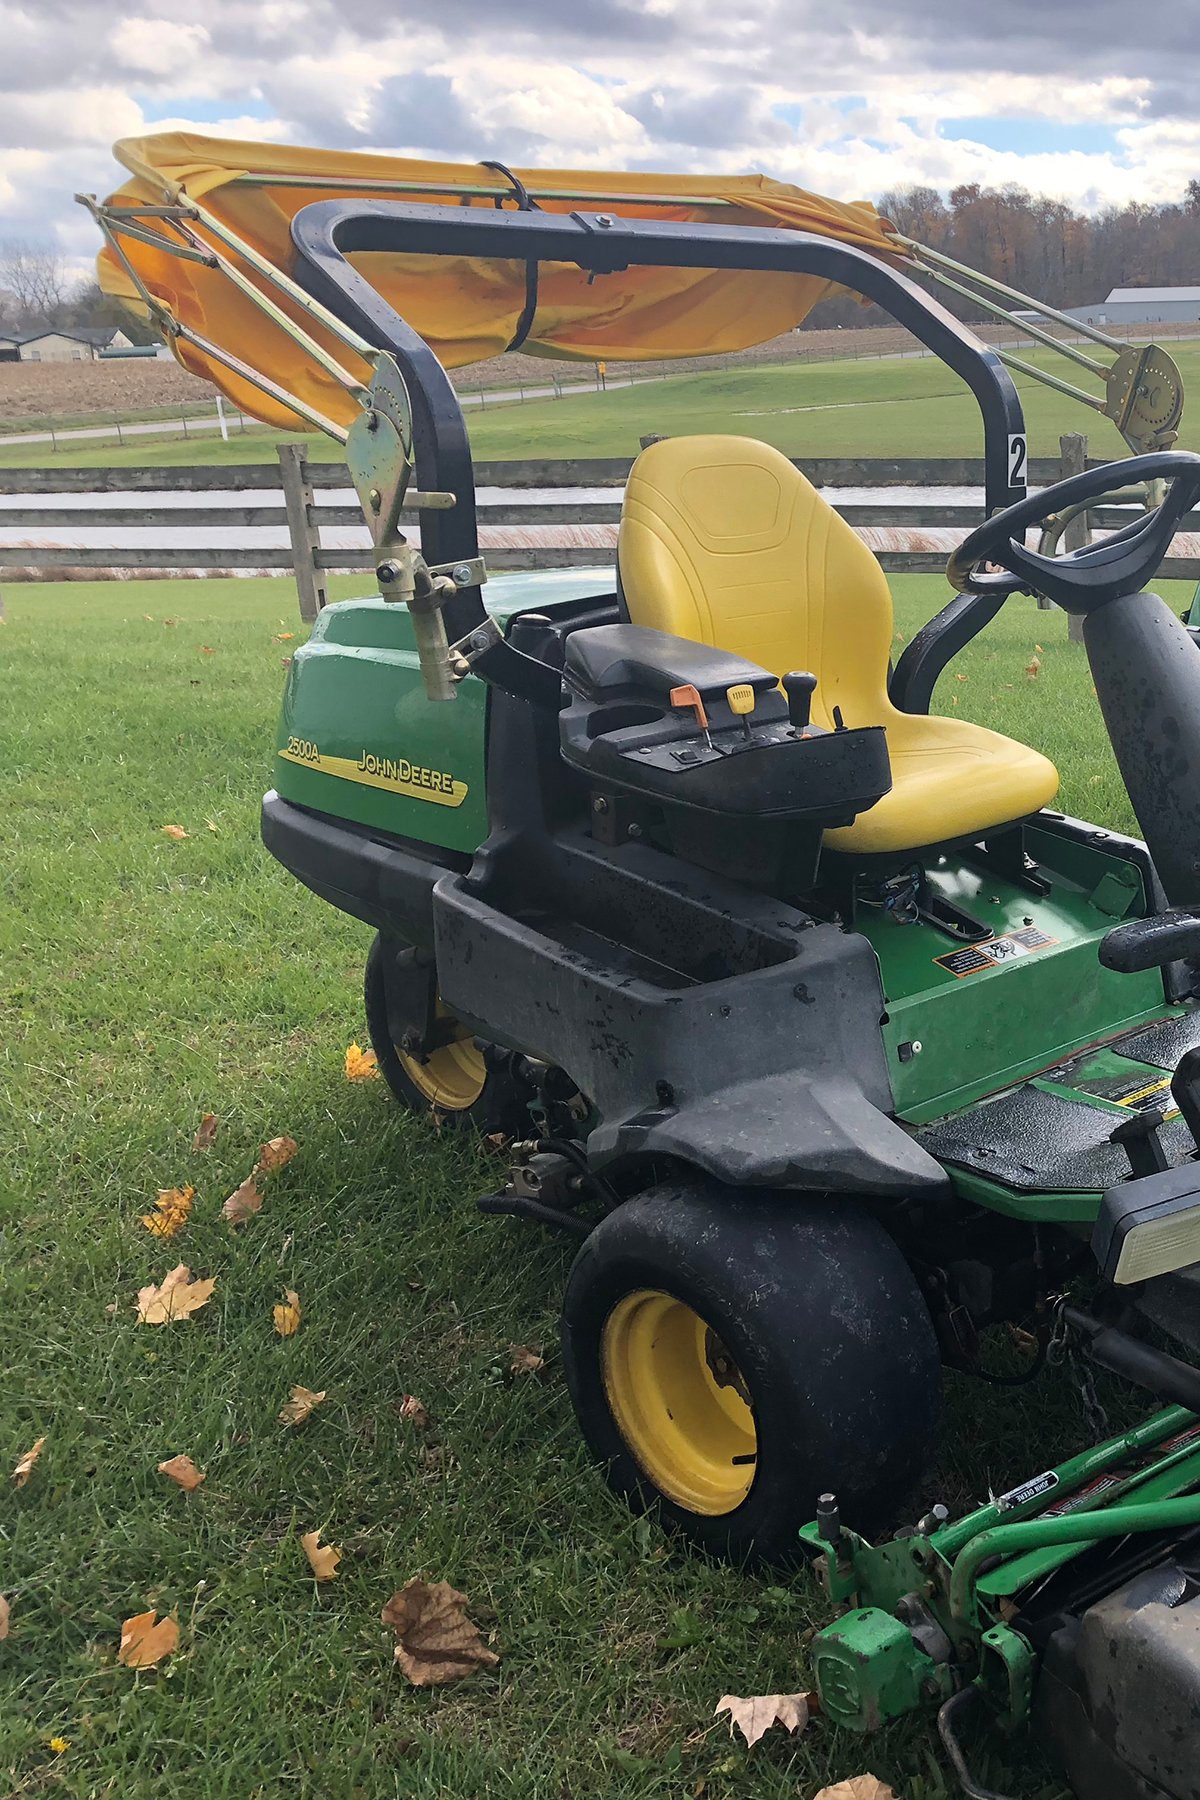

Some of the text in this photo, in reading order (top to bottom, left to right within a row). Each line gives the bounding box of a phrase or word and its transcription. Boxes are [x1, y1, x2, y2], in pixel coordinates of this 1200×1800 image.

[1009, 436, 1026, 486] 2
[287, 735, 321, 763] 2500A
[357, 749, 453, 795] JOHN DEERE
